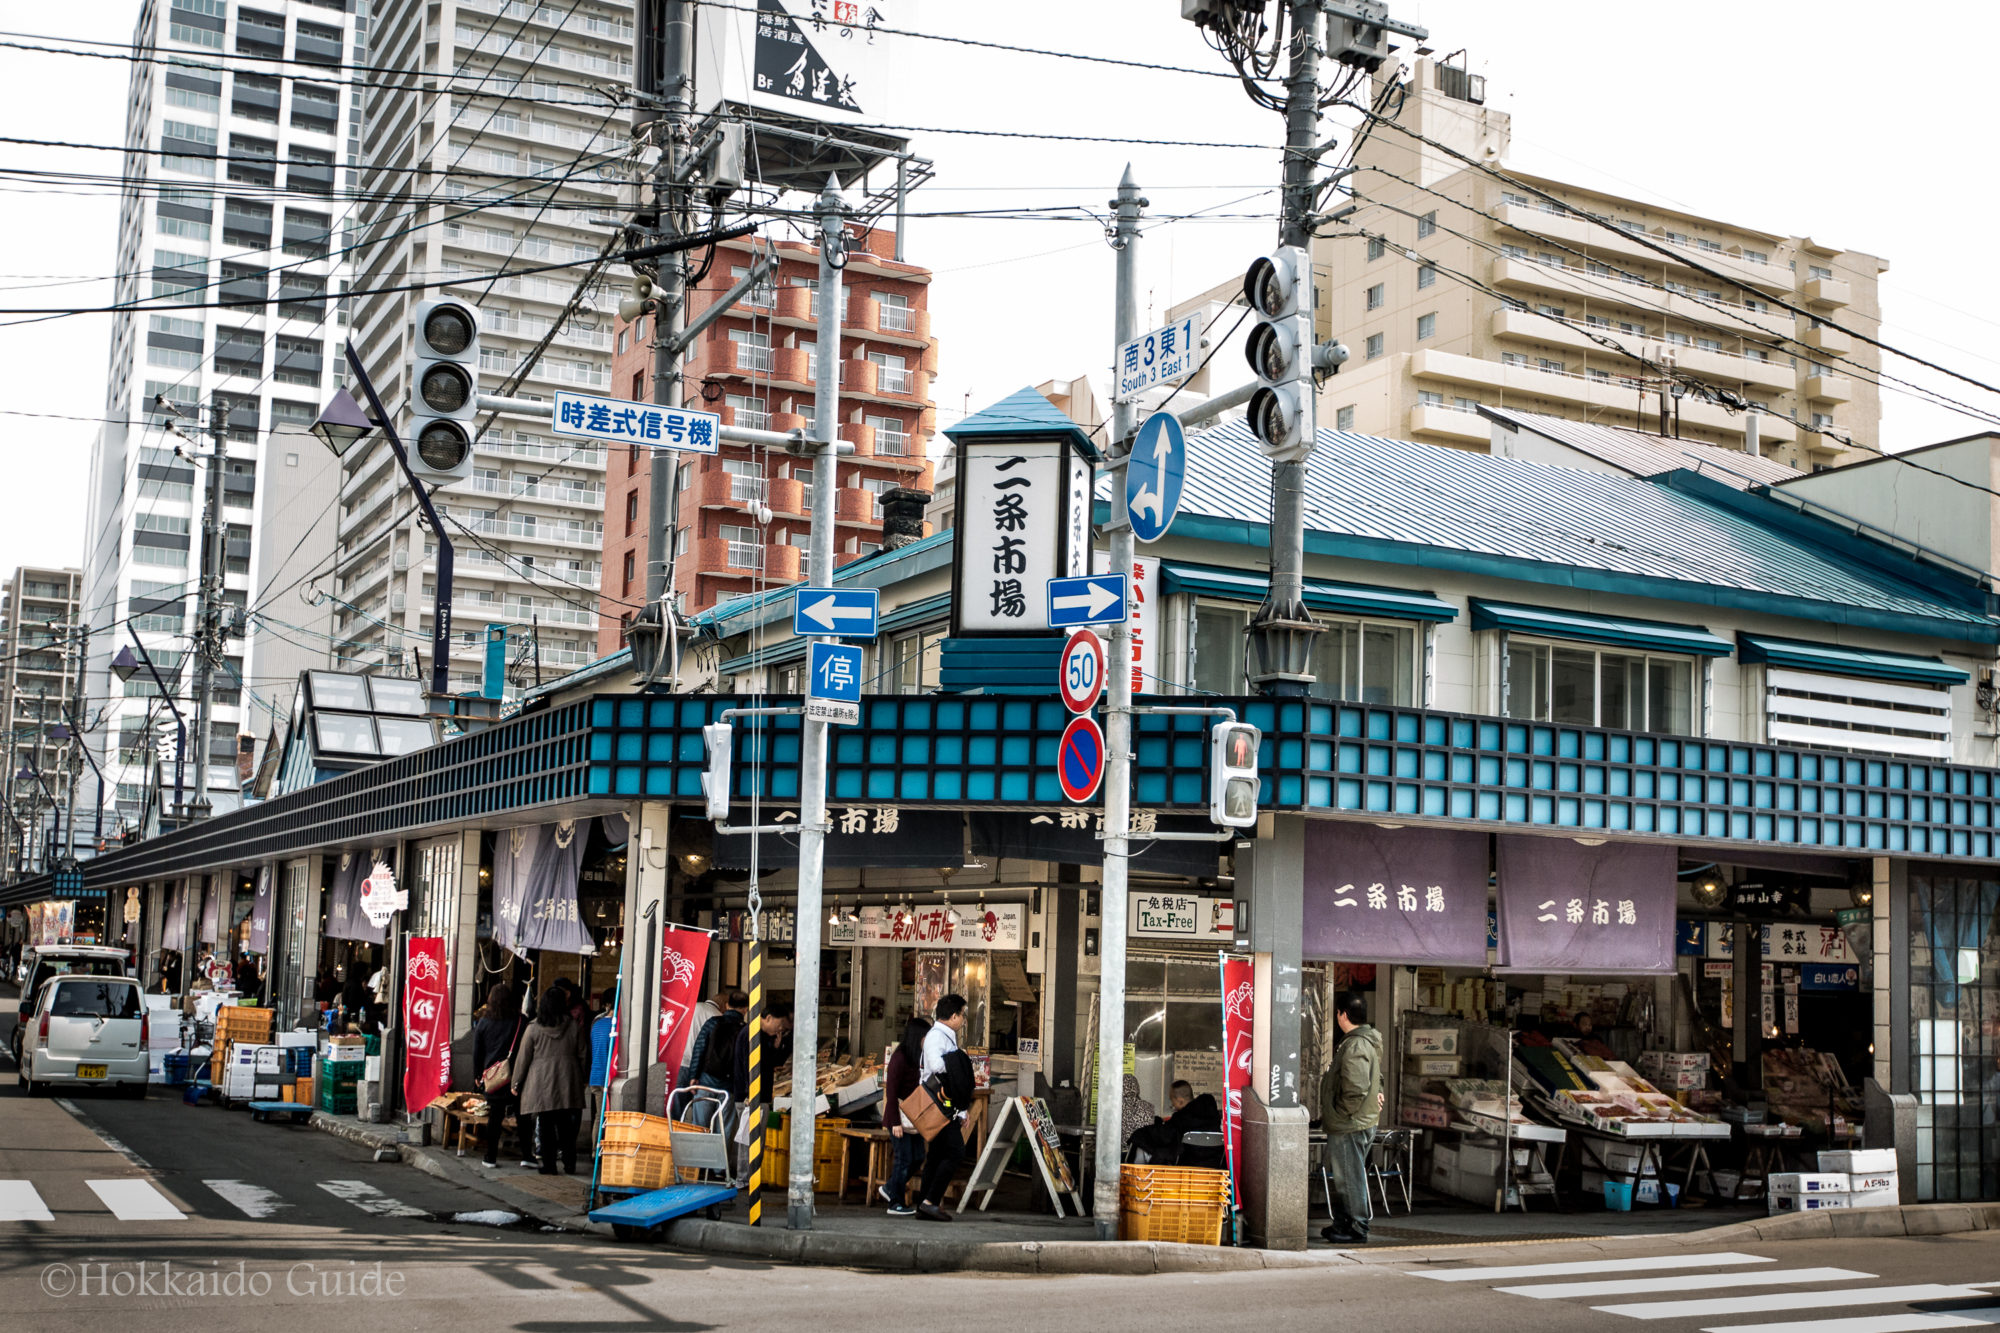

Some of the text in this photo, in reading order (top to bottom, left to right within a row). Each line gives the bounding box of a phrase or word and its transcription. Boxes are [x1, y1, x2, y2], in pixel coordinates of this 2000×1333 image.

[759, 13, 790, 28] 海鮮
[758, 25, 804, 45] 居酒屋
[1124, 320, 1191, 375] 南3東1
[1122, 352, 1190, 394] South 3 East 1
[561, 401, 713, 446] 時差式信号機
[989, 456, 1031, 618] 二条市場
[819, 654, 853, 691] 停
[1069, 652, 1093, 690] 50
[1148, 896, 1187, 910] 免税店
[1334, 883, 1446, 913] 二条市場
[1537, 898, 1637, 925] 二条市場
[1142, 911, 1193, 928] Tax-Free
[1782, 929, 1807, 942] 株式
[1782, 943, 1808, 955] 会社
[1814, 973, 1847, 985] 白い恋人
